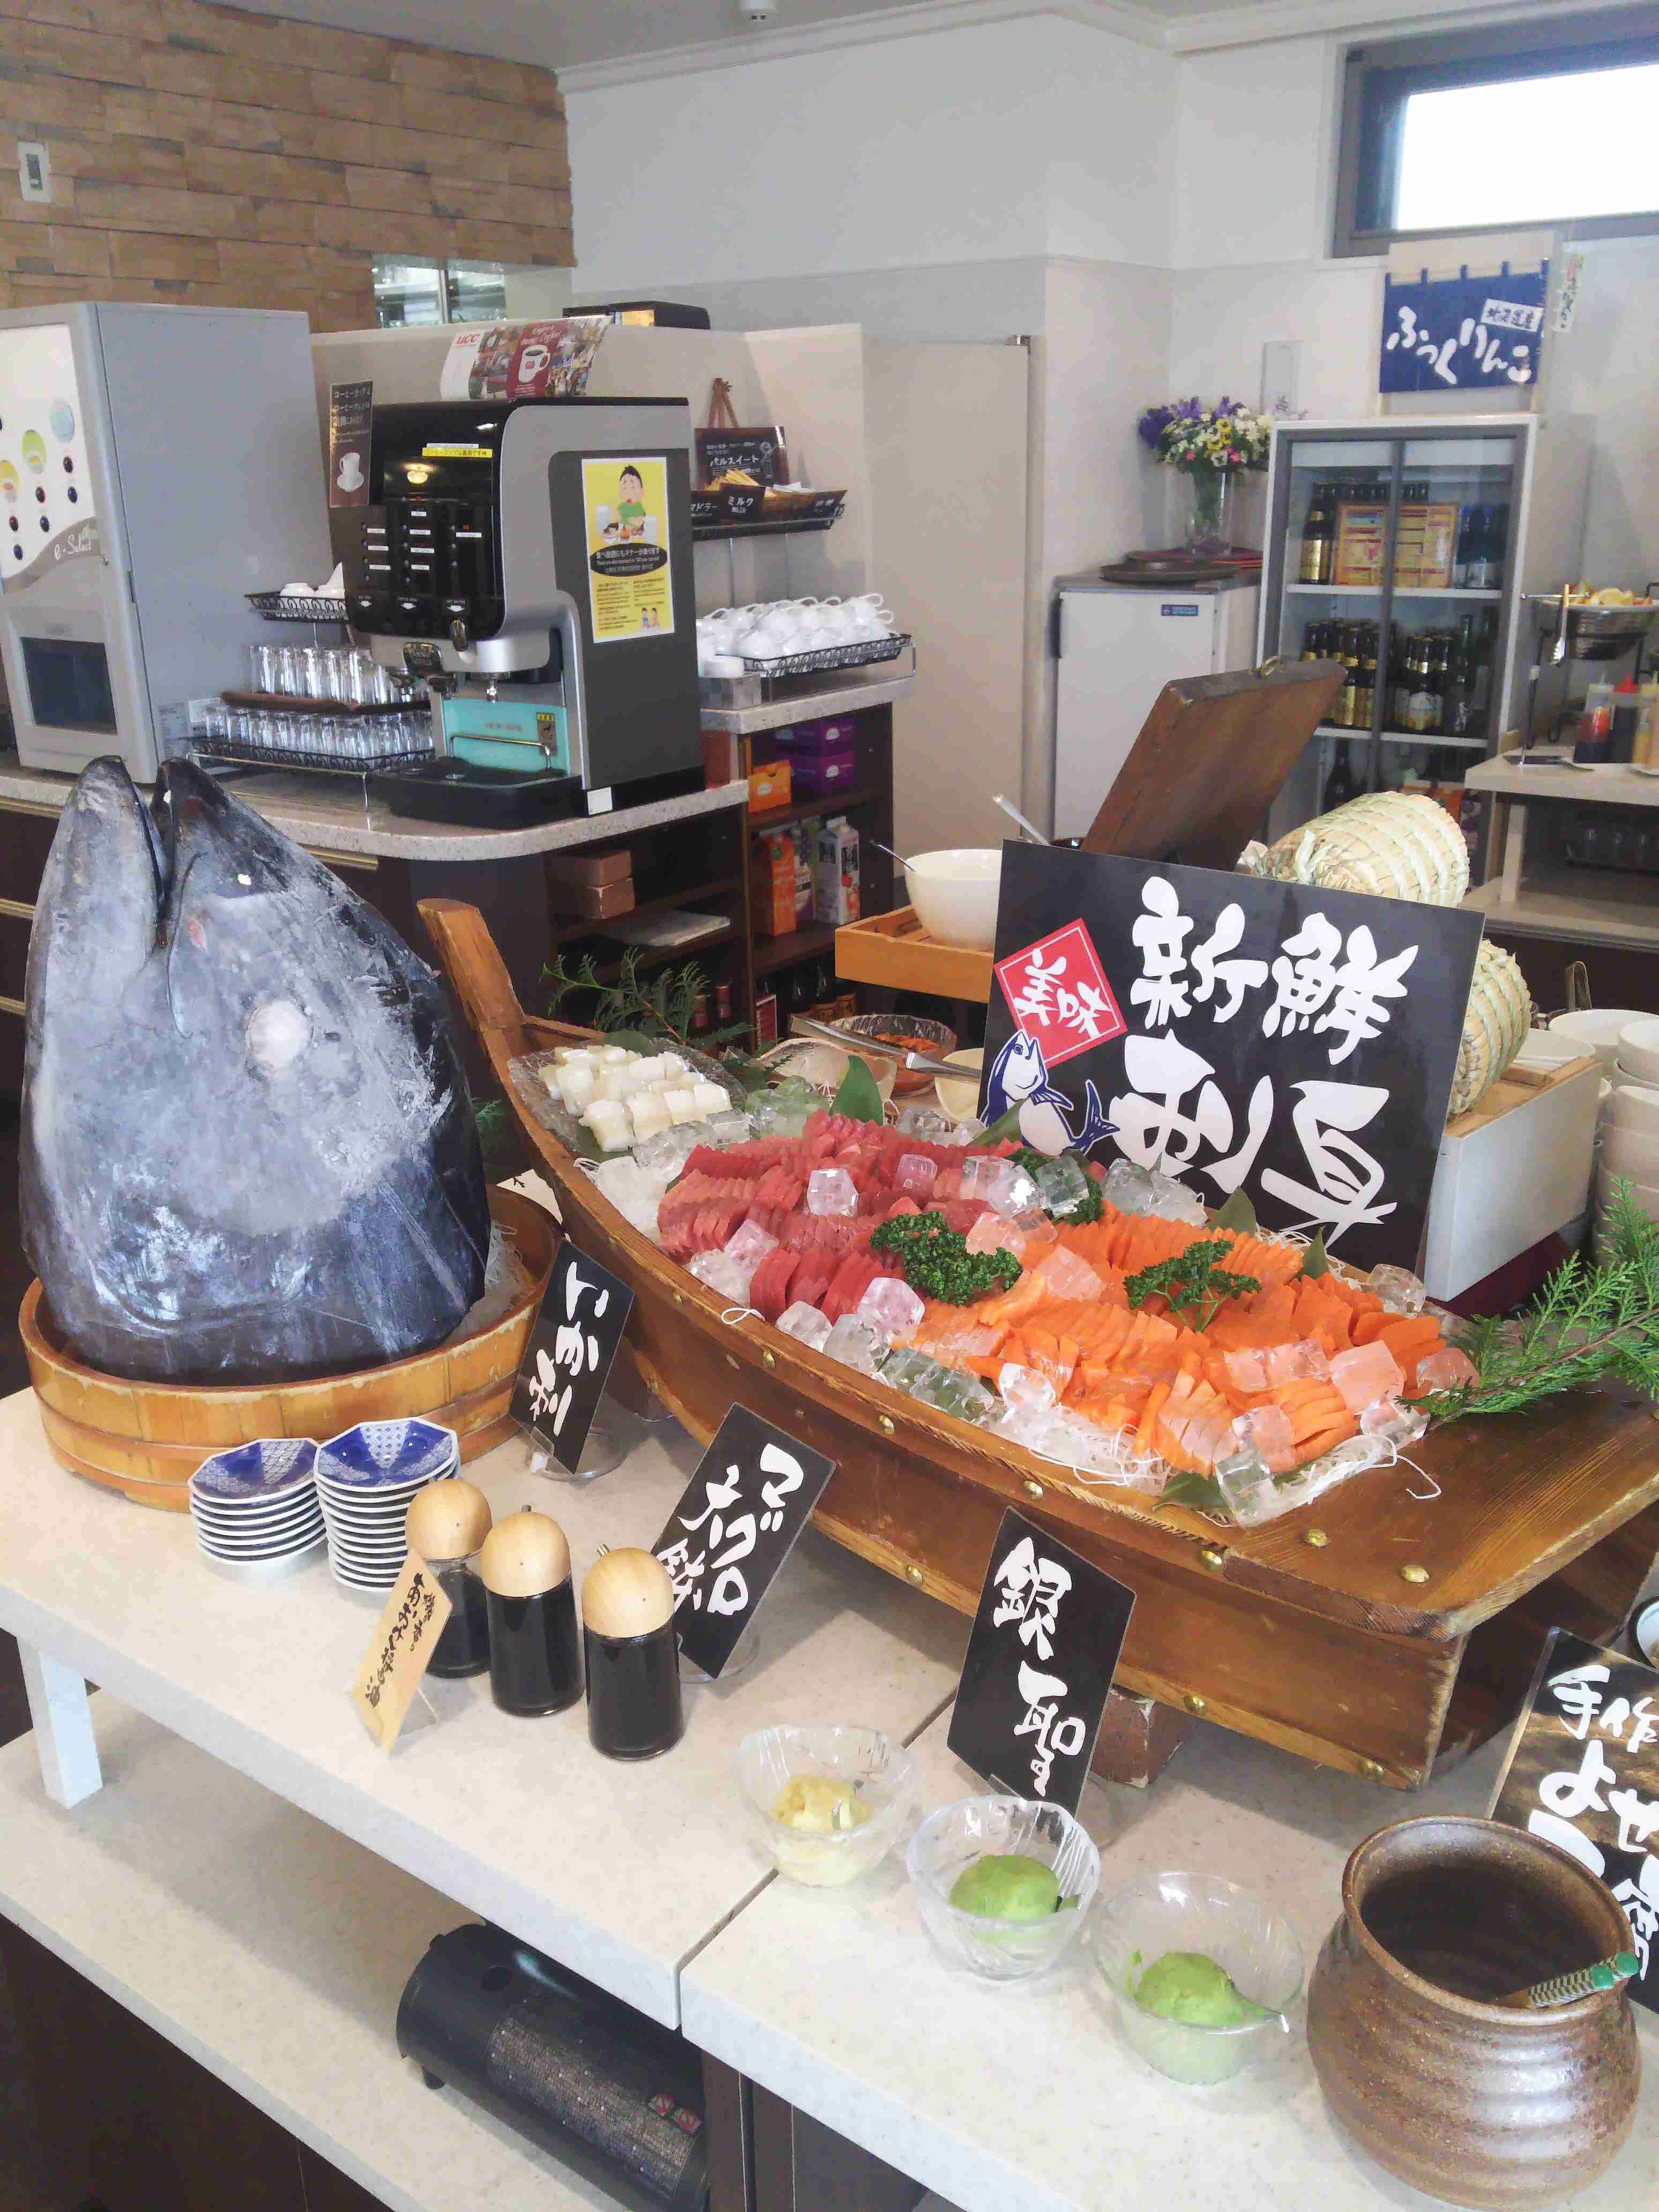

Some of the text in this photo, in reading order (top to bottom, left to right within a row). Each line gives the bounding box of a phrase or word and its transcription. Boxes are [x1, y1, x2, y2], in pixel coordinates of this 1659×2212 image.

[1386, 305, 1532, 385] ふっくりんこ
[710, 455, 759, 468] パルスイート
[728, 496, 754, 507] ミルク
[1012, 947, 1113, 1040] 美味
[1130, 876, 1418, 1065] 新鮮
[1108, 1029, 1398, 1250] 刺身
[707, 1443, 804, 1616] マグロ
[993, 1536, 1086, 1797] 銀聖
[1539, 1739, 1659, 1852] よせ
